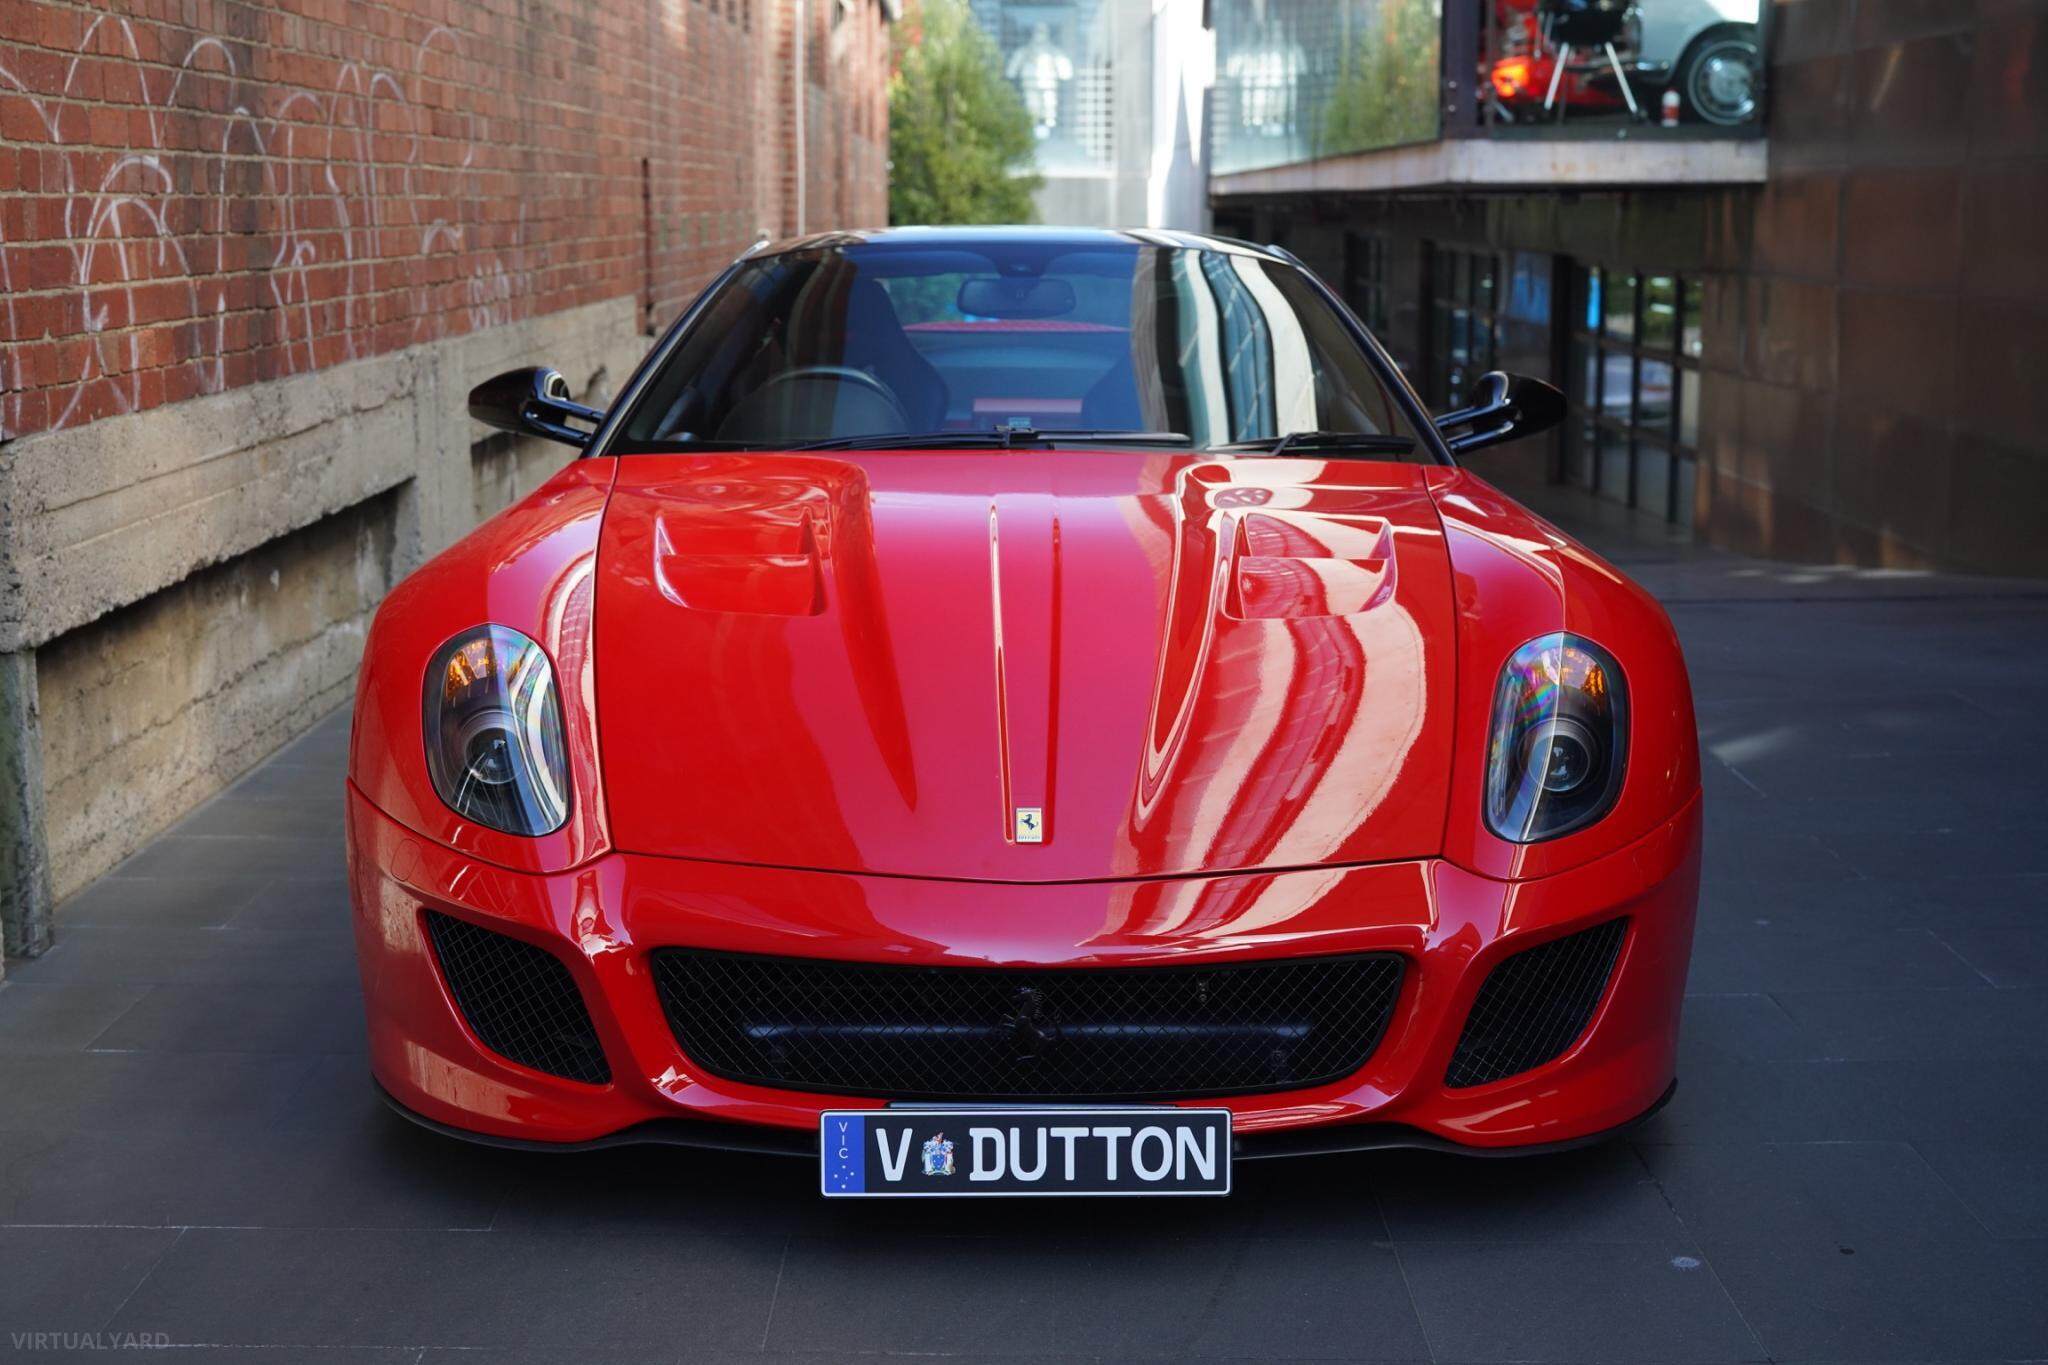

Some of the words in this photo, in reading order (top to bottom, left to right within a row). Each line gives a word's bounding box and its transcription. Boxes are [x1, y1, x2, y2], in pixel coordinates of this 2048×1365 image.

[838, 1121, 849, 1159] VIC
[875, 1128, 913, 1182] V
[969, 1125, 1216, 1182] DUTTON
